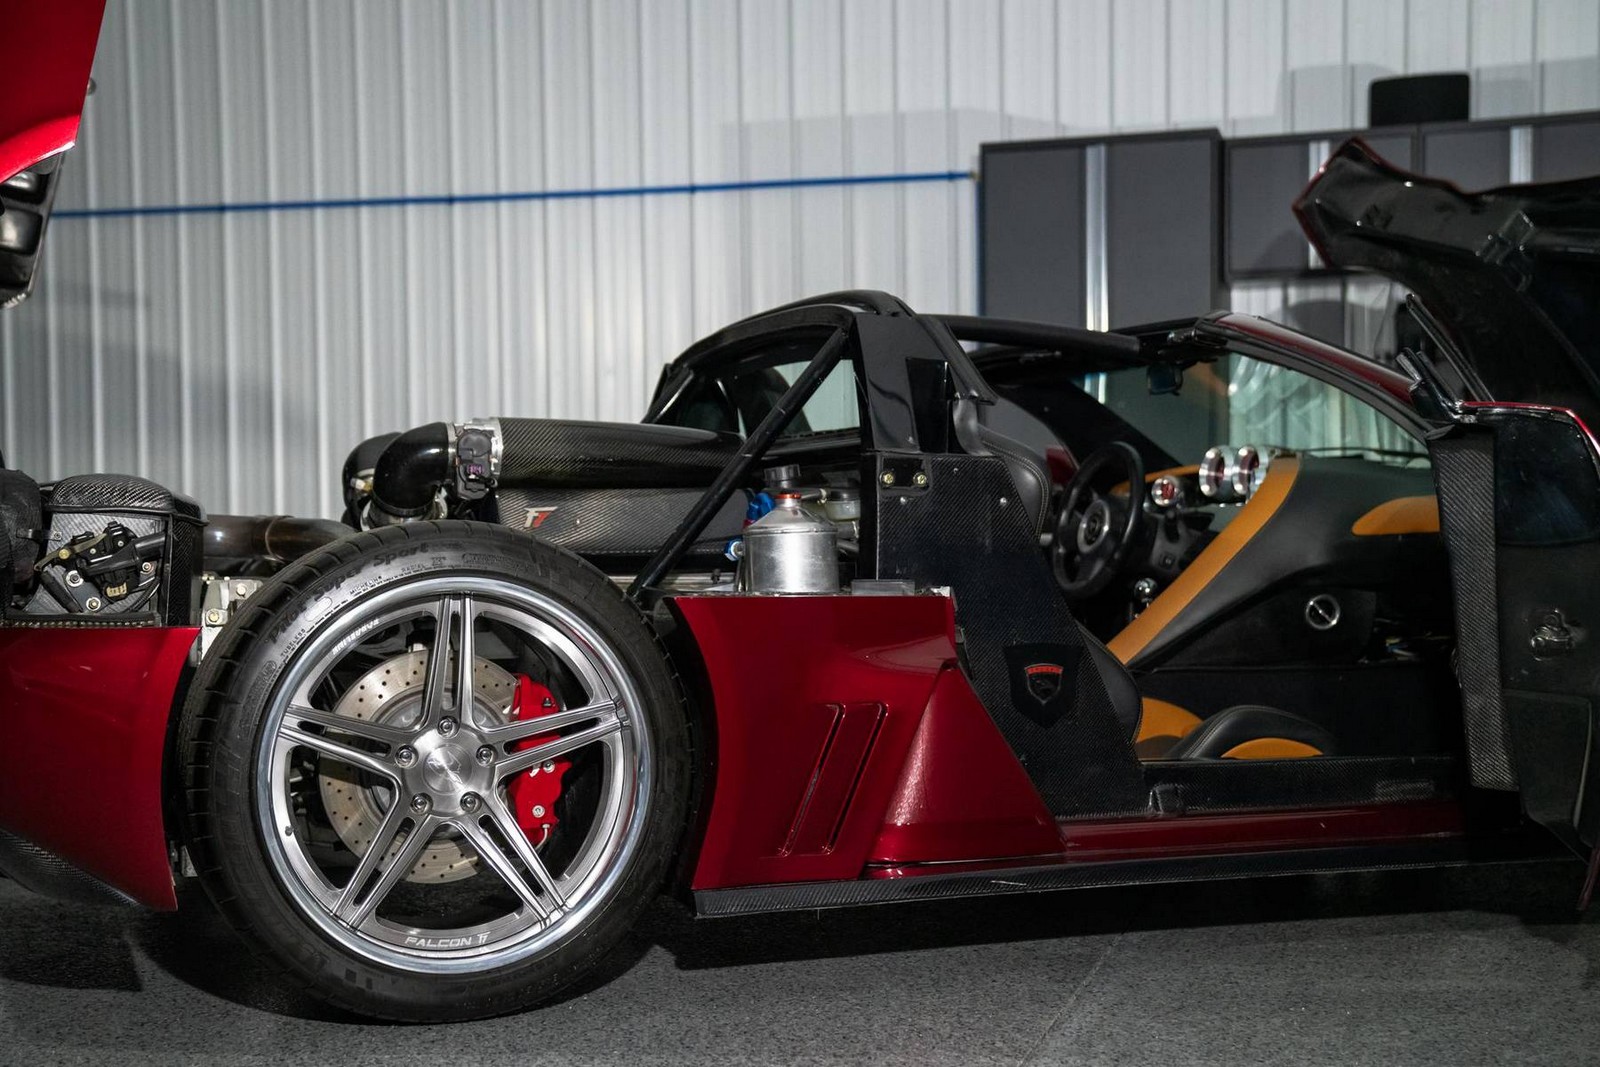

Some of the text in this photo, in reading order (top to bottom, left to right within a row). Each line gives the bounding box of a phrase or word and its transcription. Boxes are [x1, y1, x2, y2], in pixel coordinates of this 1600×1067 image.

[313, 564, 362, 602] Super
[373, 542, 429, 567] Sport
[404, 936, 472, 948] FALCON
